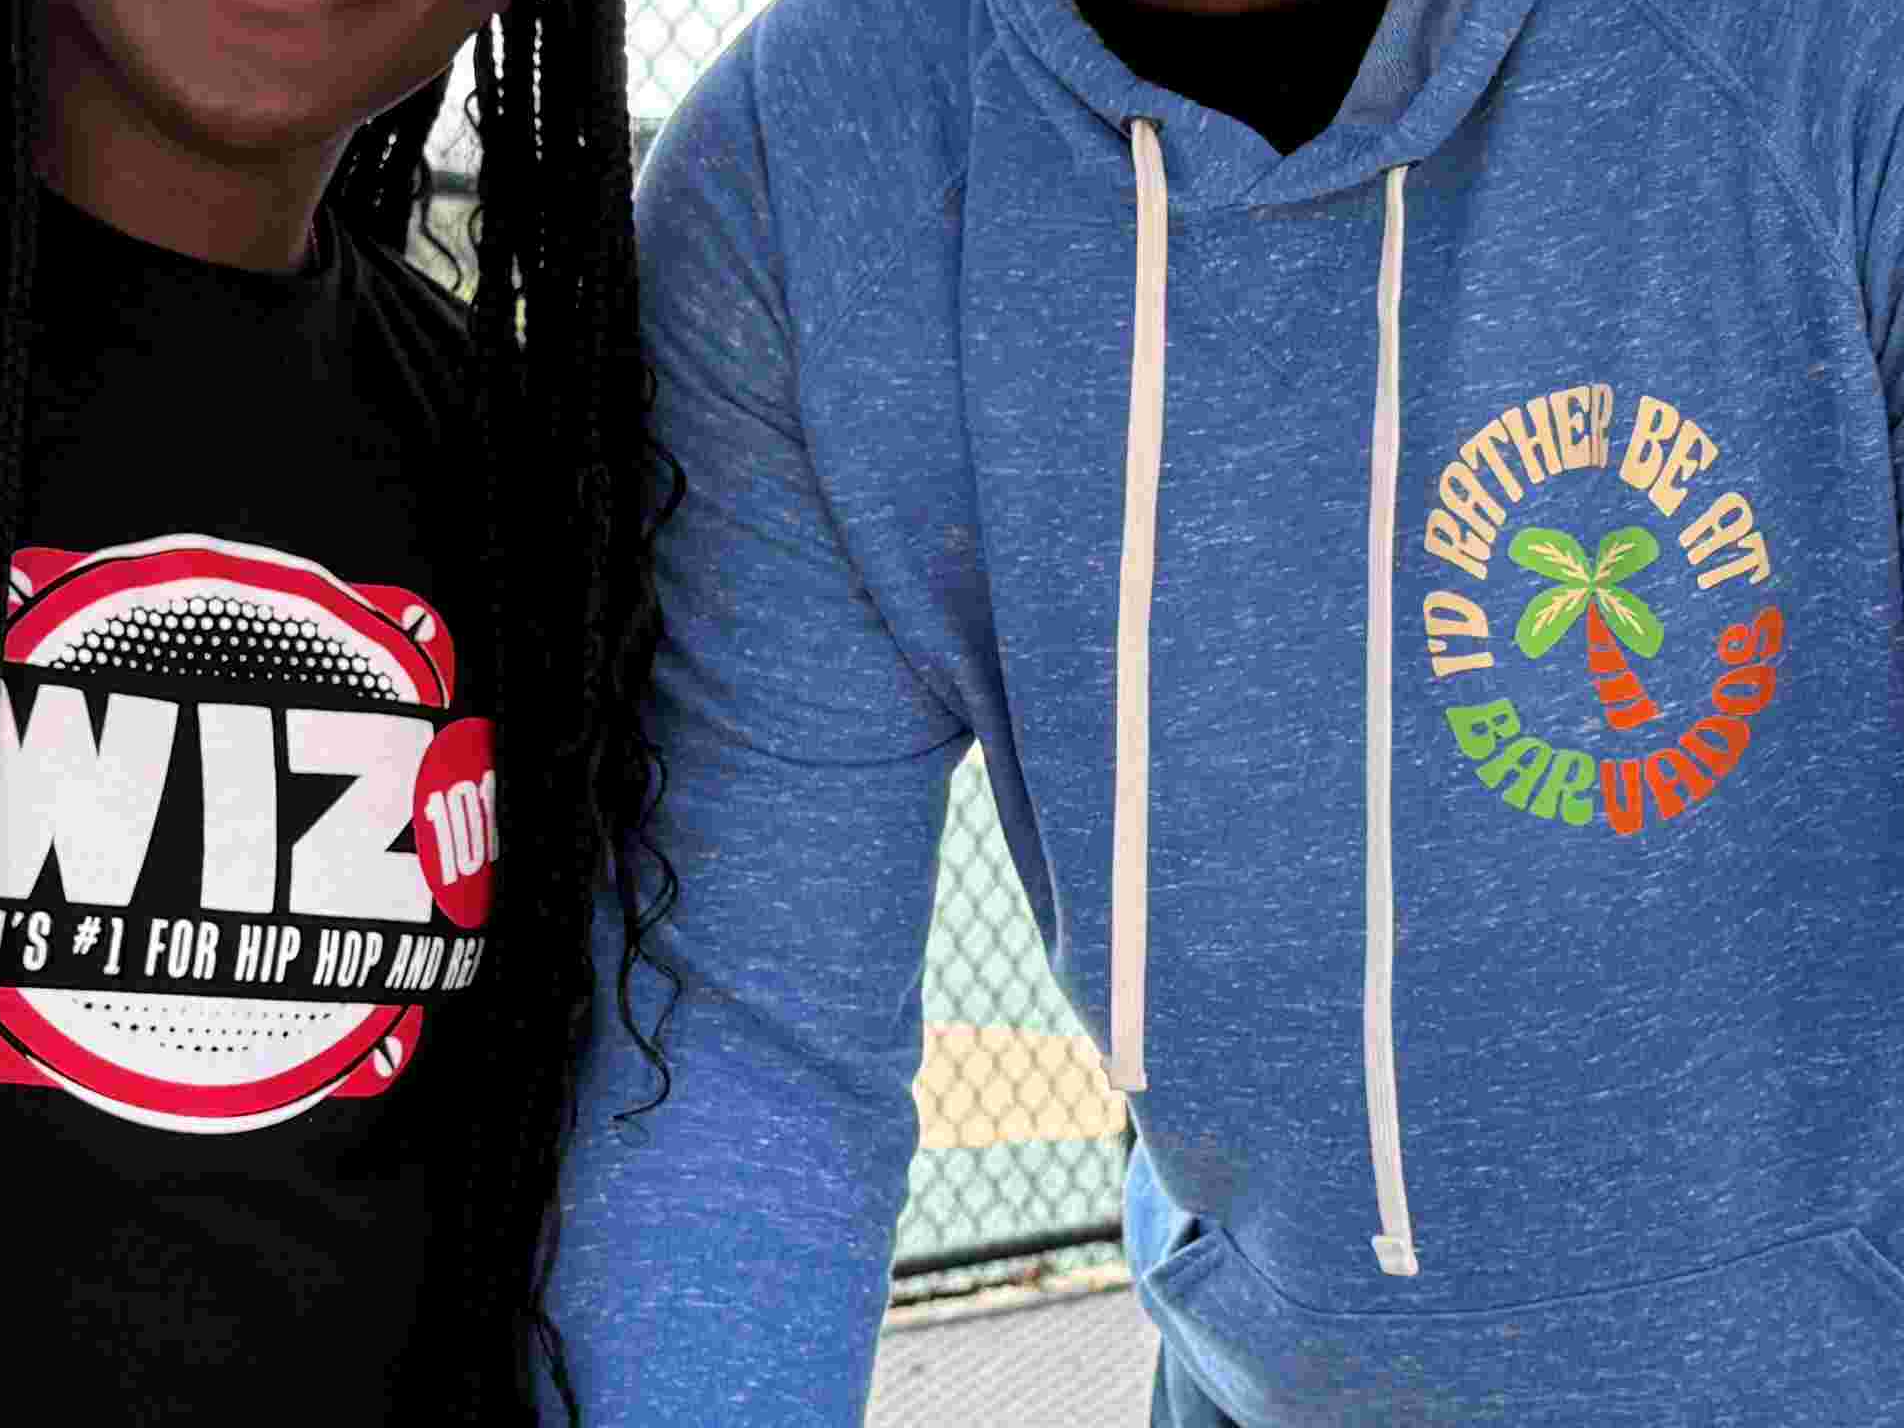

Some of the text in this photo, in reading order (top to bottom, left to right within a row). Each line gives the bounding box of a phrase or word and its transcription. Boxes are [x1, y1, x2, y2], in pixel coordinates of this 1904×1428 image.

[1423, 383, 1771, 677] I'D RATHER BE AT
[72, 915, 124, 975] #1
[143, 918, 220, 980] FOR
[233, 923, 302, 984] HIP
[311, 927, 384, 990] HOP
[384, 933, 446, 991] AND
